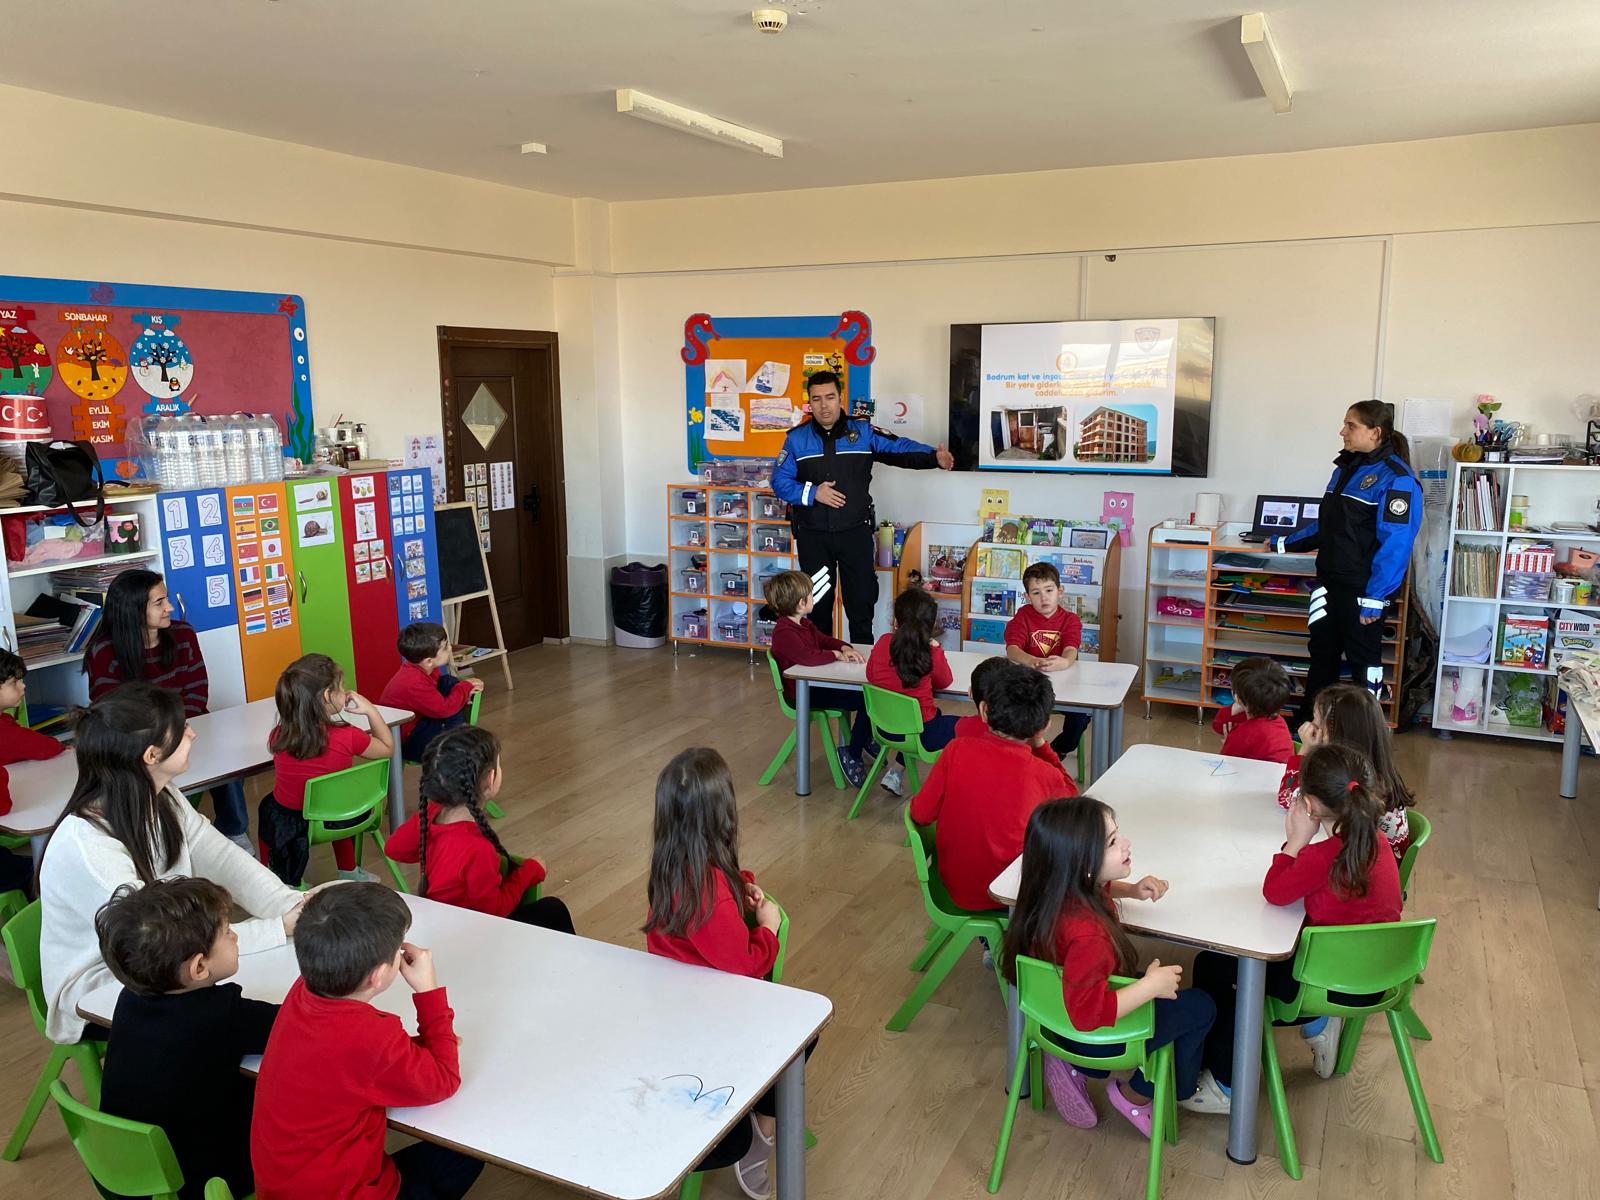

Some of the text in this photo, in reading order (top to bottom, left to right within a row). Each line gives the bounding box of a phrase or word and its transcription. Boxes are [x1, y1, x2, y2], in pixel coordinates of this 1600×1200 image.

[64, 312, 108, 322] SONBAHAR
[151, 315, 163, 325] KIŞ
[88, 405, 112, 415] EYLÜL
[155, 404, 180, 412] ARALIK
[92, 420, 110, 429] EKİM
[90, 435, 114, 444] KASIM
[167, 498, 221, 528] 1 2
[170, 537, 224, 568] 3 4
[209, 577, 226, 605] 5
[1558, 621, 1590, 632] CITY WOOD
